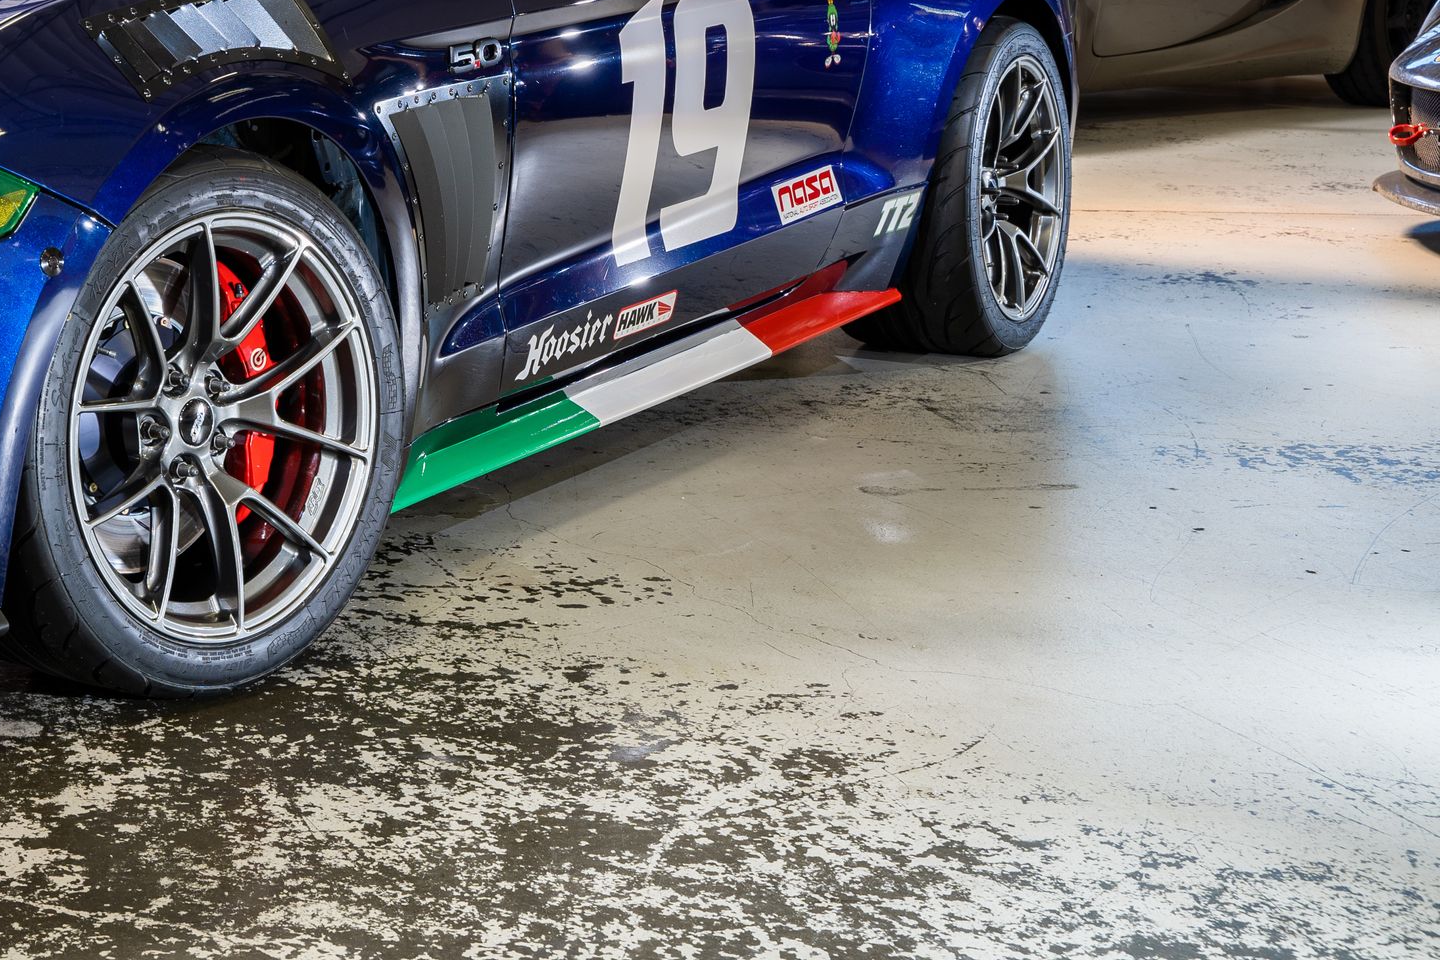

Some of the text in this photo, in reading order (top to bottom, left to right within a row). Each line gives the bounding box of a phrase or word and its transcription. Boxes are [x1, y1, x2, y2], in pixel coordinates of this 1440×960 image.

[448, 37, 502, 74] 5.0
[777, 169, 835, 213] nasa
[873, 191, 921, 238] TT2
[514, 308, 614, 382] Hoosier
[617, 300, 658, 332] HAWK
